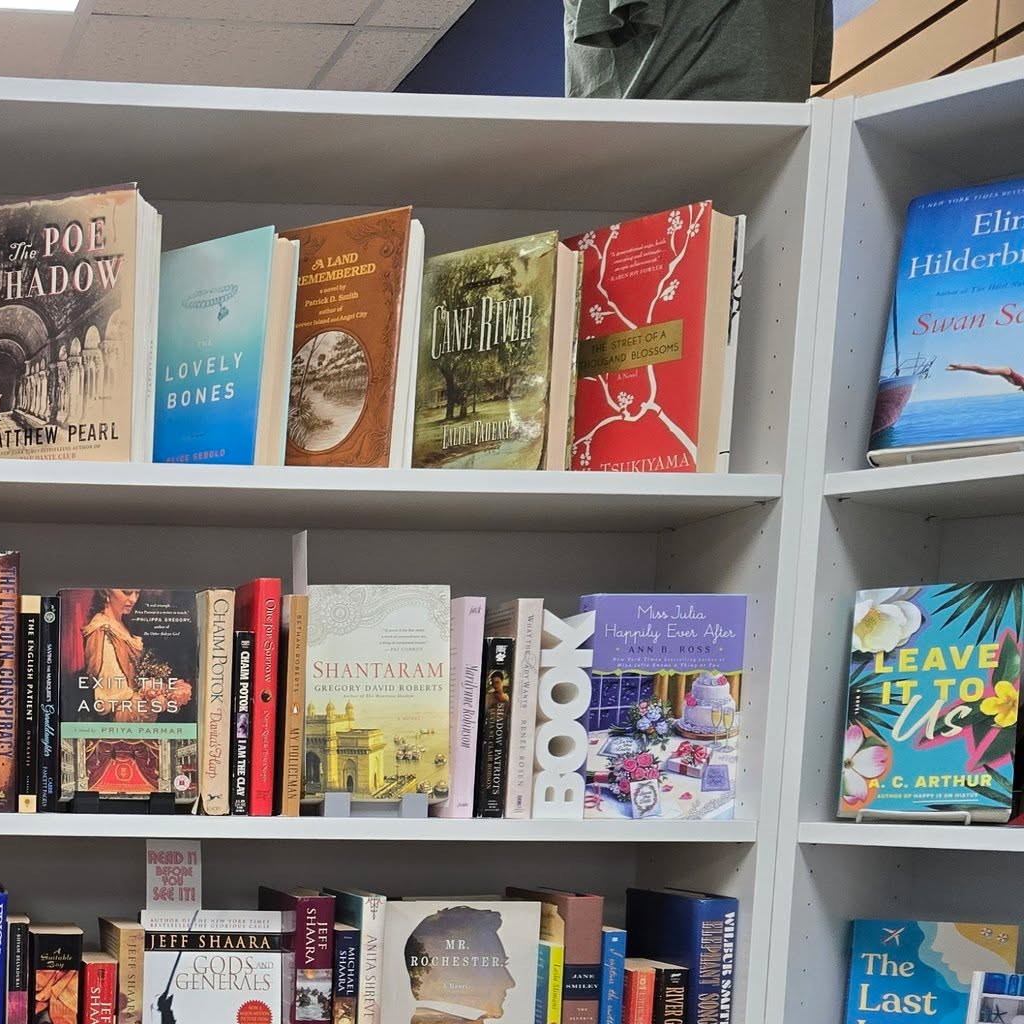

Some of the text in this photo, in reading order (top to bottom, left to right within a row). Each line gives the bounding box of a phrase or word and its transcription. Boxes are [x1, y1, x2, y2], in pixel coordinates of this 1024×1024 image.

[9, 219, 107, 263] The POE
[305, 292, 358, 307] Patrick D. Smith
[430, 296, 532, 360] CANE RIVER
[912, 313, 985, 335] Swan
[165, 352, 243, 382] LOVELY
[167, 383, 236, 409] BONES
[68, 422, 119, 443] PEARL
[637, 605, 706, 620] Miss Julia
[605, 624, 736, 644] Happily Ever After
[210, 599, 229, 703] CHAIM POTOK
[875, 644, 999, 673] LEAVE
[313, 661, 443, 679] SHANTARAM
[78, 676, 179, 690] EXIT THE
[365, 684, 395, 692] DAVID
[399, 684, 443, 692] ROBERTS
[882, 678, 984, 705] IT TO
[77, 700, 178, 713] ACTRESS
[532, 609, 596, 819] BOOK
[892, 695, 973, 741] Us
[869, 774, 992, 788] A. C. ARTHUR
[148, 851, 183, 864] READ
[156, 867, 193, 877] BEFORE
[162, 877, 183, 886] YOU
[153, 888, 196, 901] SEE IT!
[150, 934, 271, 948] JEFF SHAARA
[446, 940, 469, 949] MR.
[194, 956, 254, 972] GODS
[411, 957, 505, 967] ROCHESTER.
[862, 953, 914, 977] The
[176, 973, 272, 990] GENERALS
[858, 984, 938, 1015] Last
